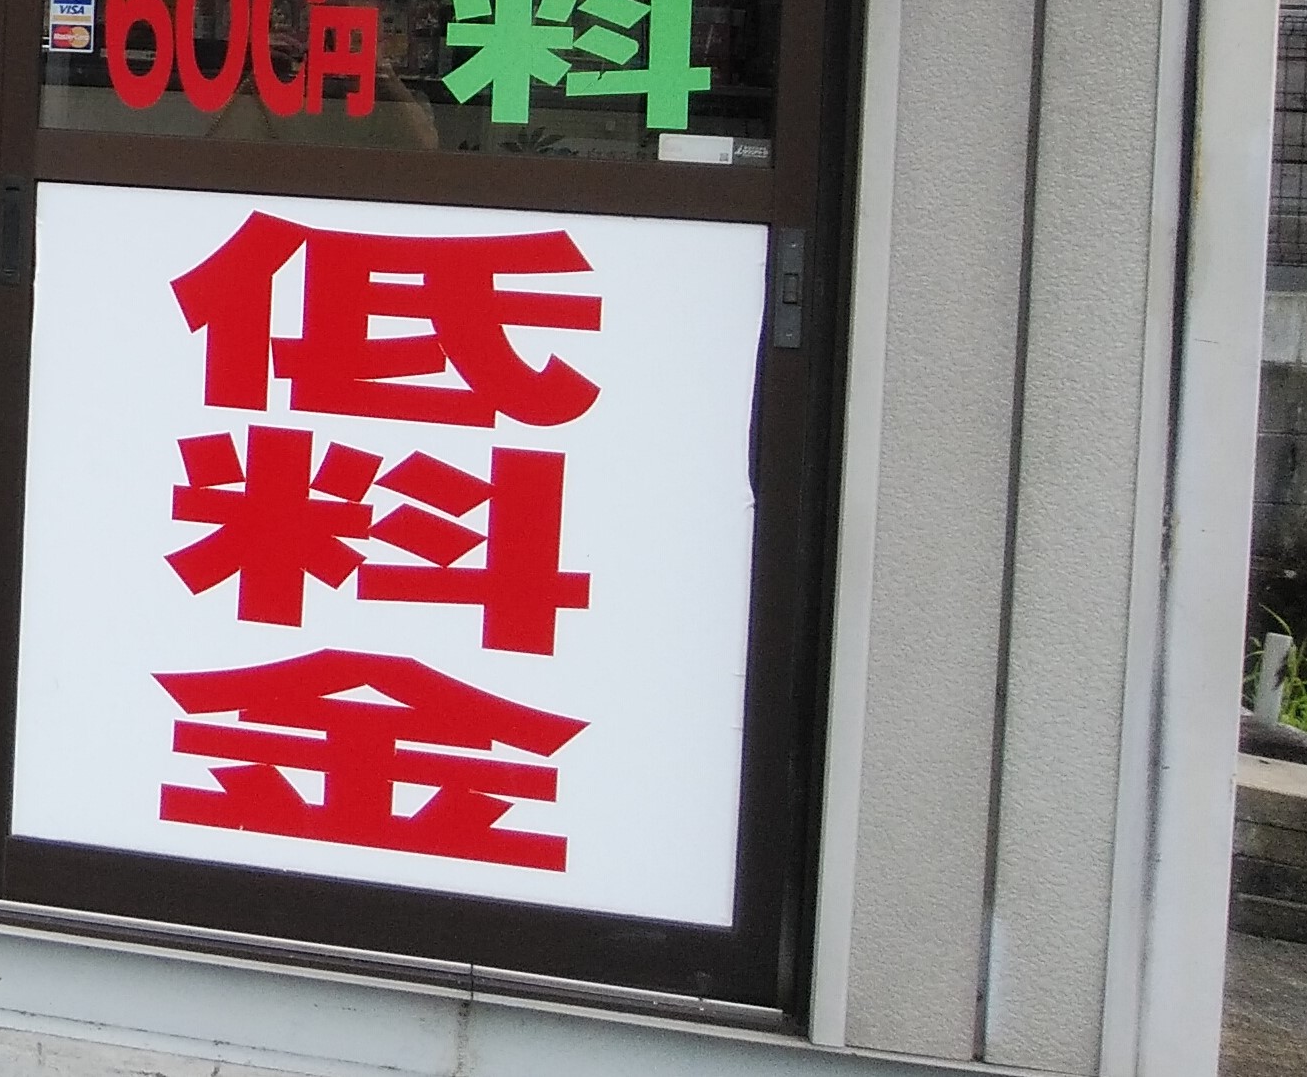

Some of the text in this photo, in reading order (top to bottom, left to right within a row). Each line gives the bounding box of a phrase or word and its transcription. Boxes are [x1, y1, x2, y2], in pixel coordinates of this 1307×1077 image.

[59, 5, 85, 14] VISA
[150, 209, 603, 873] 低料金
